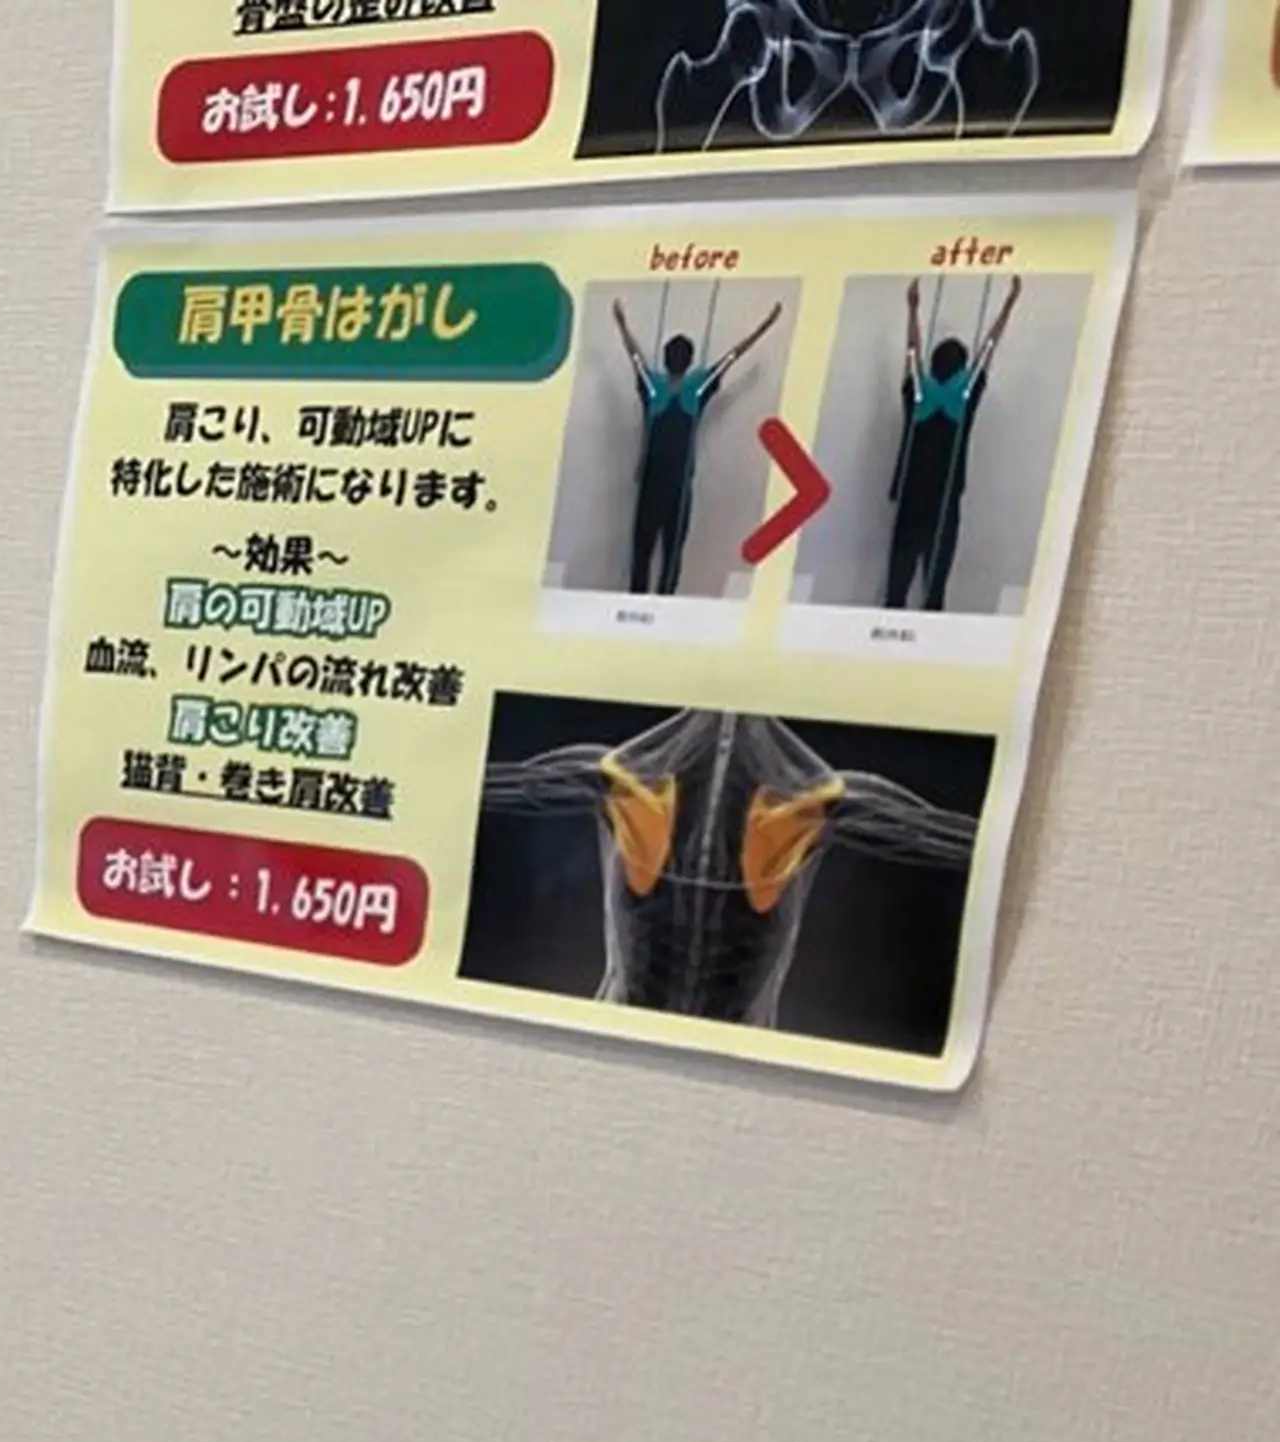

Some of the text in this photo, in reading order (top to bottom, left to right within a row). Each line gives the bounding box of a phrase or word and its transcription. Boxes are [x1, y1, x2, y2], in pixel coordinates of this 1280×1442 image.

[649, 243, 740, 273] before
[930, 237, 1014, 267] after
[178, 284, 478, 345] 肩甲骨はがし
[164, 402, 474, 448] 肩こり、可動域UPに
[110, 458, 498, 513] 特化した施術になります。
[164, 577, 392, 638] 肩の可動域UP
[84, 636, 466, 706] 血流、リンパの流れ改善
[169, 697, 356, 758] 肩こり改善
[121, 750, 393, 819] 猫背・巻き肩改善
